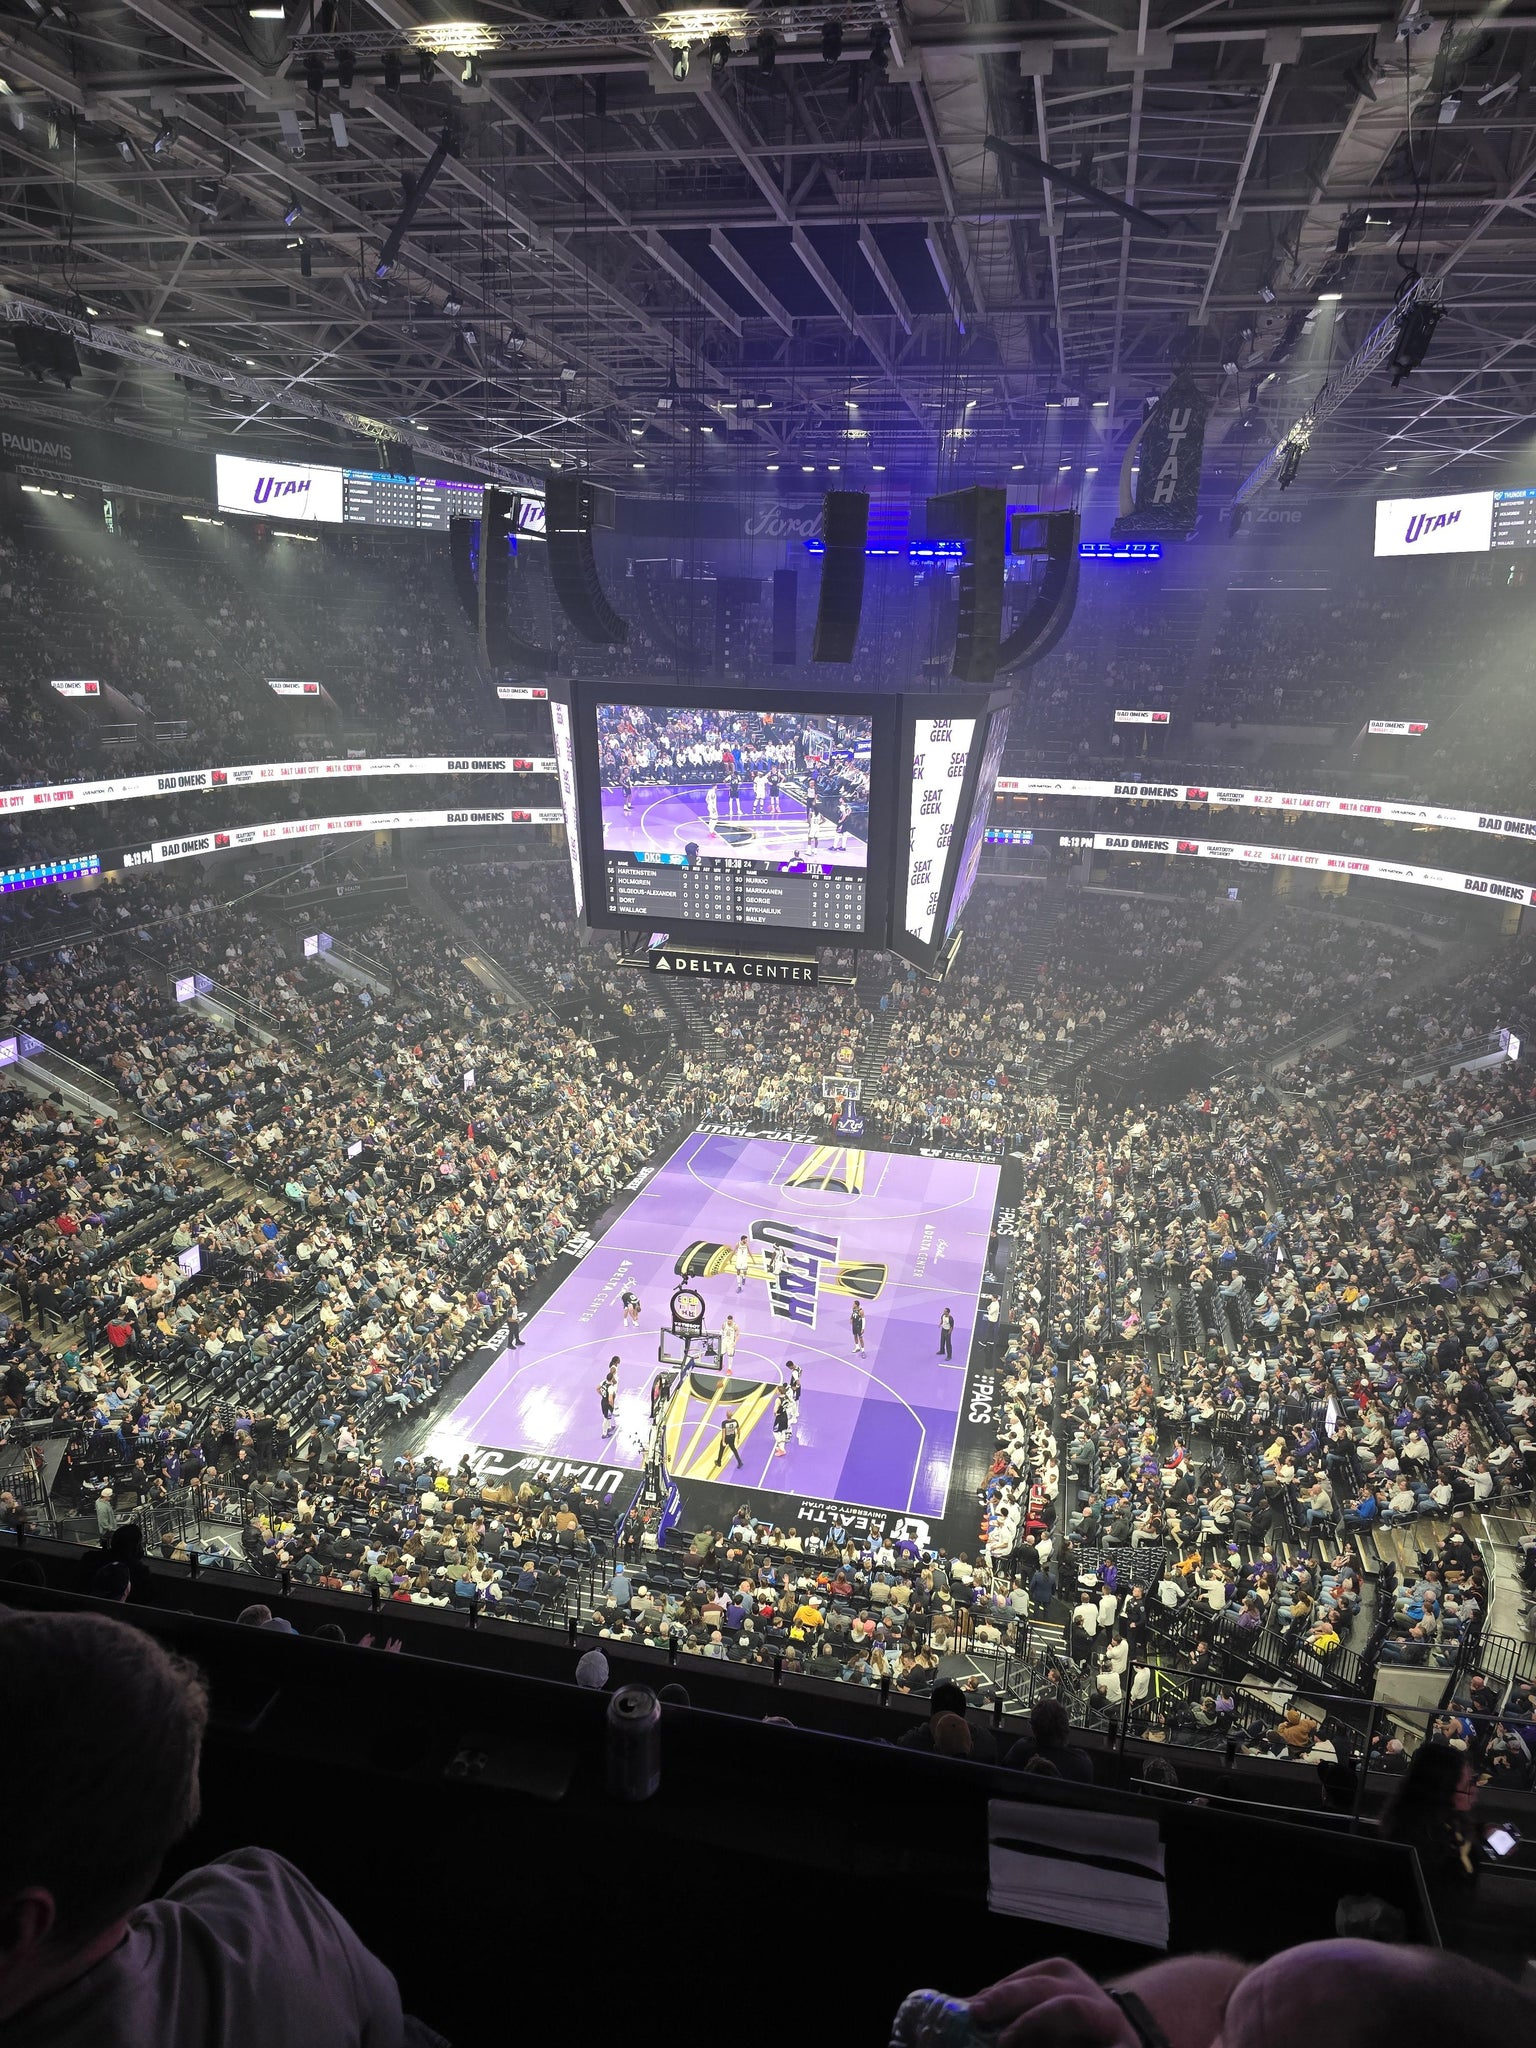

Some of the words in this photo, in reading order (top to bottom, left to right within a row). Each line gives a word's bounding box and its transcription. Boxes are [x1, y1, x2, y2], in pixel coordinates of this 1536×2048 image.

[1152, 408, 1191, 504] UTAH
[254, 477, 312, 504] UTAH
[744, 504, 823, 536] Ford
[1220, 508, 1252, 523] Fn
[1256, 508, 1302, 523] Zone
[1405, 510, 1462, 543] UTAH
[933, 720, 952, 728] SEAT
[930, 730, 952, 742] GEEK
[260, 769, 274, 778] 02.22
[280, 768, 293, 776] SALT
[295, 767, 306, 775] LAKE
[448, 760, 469, 770] BAD
[471, 760, 506, 770] OMENS
[948, 766, 966, 777] GEE
[158, 776, 176, 790] BAD
[179, 774, 206, 788] OMENS
[10, 796, 24, 808] CITY
[34, 793, 51, 804] DELTA
[53, 790, 74, 802] CENTER
[923, 789, 943, 802] SEAT
[1114, 785, 1138, 795] BAD
[1140, 786, 1178, 797] OMENS
[920, 802, 941, 815] GEEK
[1254, 795, 1273, 803] 02.22
[1281, 797, 1297, 806] SALT
[1299, 799, 1315, 807] LAKE
[1316, 800, 1330, 808] CITY
[1339, 803, 1358, 811] DELTA
[1360, 804, 1382, 813] CENTER
[447, 813, 468, 823] BAD
[471, 812, 504, 822] OMENS
[1478, 817, 1502, 830] BAD
[1504, 820, 1536, 835] OMENS
[263, 829, 276, 837] 02.22
[282, 827, 295, 835] SALT
[162, 843, 180, 857] BAD
[182, 838, 209, 852] OMENS
[1080, 838, 1093, 848] PM
[1106, 838, 1129, 848] BAD
[1131, 839, 1169, 850] OMENS
[142, 850, 152, 863] PM
[644, 853, 661, 863] OKC
[696, 857, 701, 865] 2
[764, 862, 770, 870] 7
[806, 863, 823, 874] UTA
[1244, 850, 1262, 858] 02.22
[1328, 859, 1345, 868] DELTA
[1348, 862, 1369, 871] CENTER
[618, 868, 657, 876] HARTENSTEIN
[913, 860, 932, 873] SEAT
[911, 872, 931, 885] GEEK
[746, 887, 783, 895] MARKKANEN
[1465, 879, 1487, 892] BAD
[1490, 884, 1524, 900] OMENS
[676, 959, 735, 974] DELTA
[743, 964, 812, 980] CENTER
[696, 1124, 748, 1136] UTAH
[766, 1132, 818, 1143] JAZZ
[945, 1152, 996, 1161] HEALTH
[997, 1212, 1016, 1235] PACS
[920, 1231, 935, 1253] DELTA
[913, 1252, 928, 1278] CENTER
[602, 1267, 629, 1291] DELTA
[749, 1219, 841, 1331] UTAH
[579, 1293, 608, 1322] CENTER
[968, 1383, 994, 1424] PACS
[533, 1459, 624, 1494] UTAH
[802, 1501, 824, 1509] UTAH
[839, 1507, 887, 1520] UNIVERSITY
[798, 1508, 885, 1532] HEALTH
